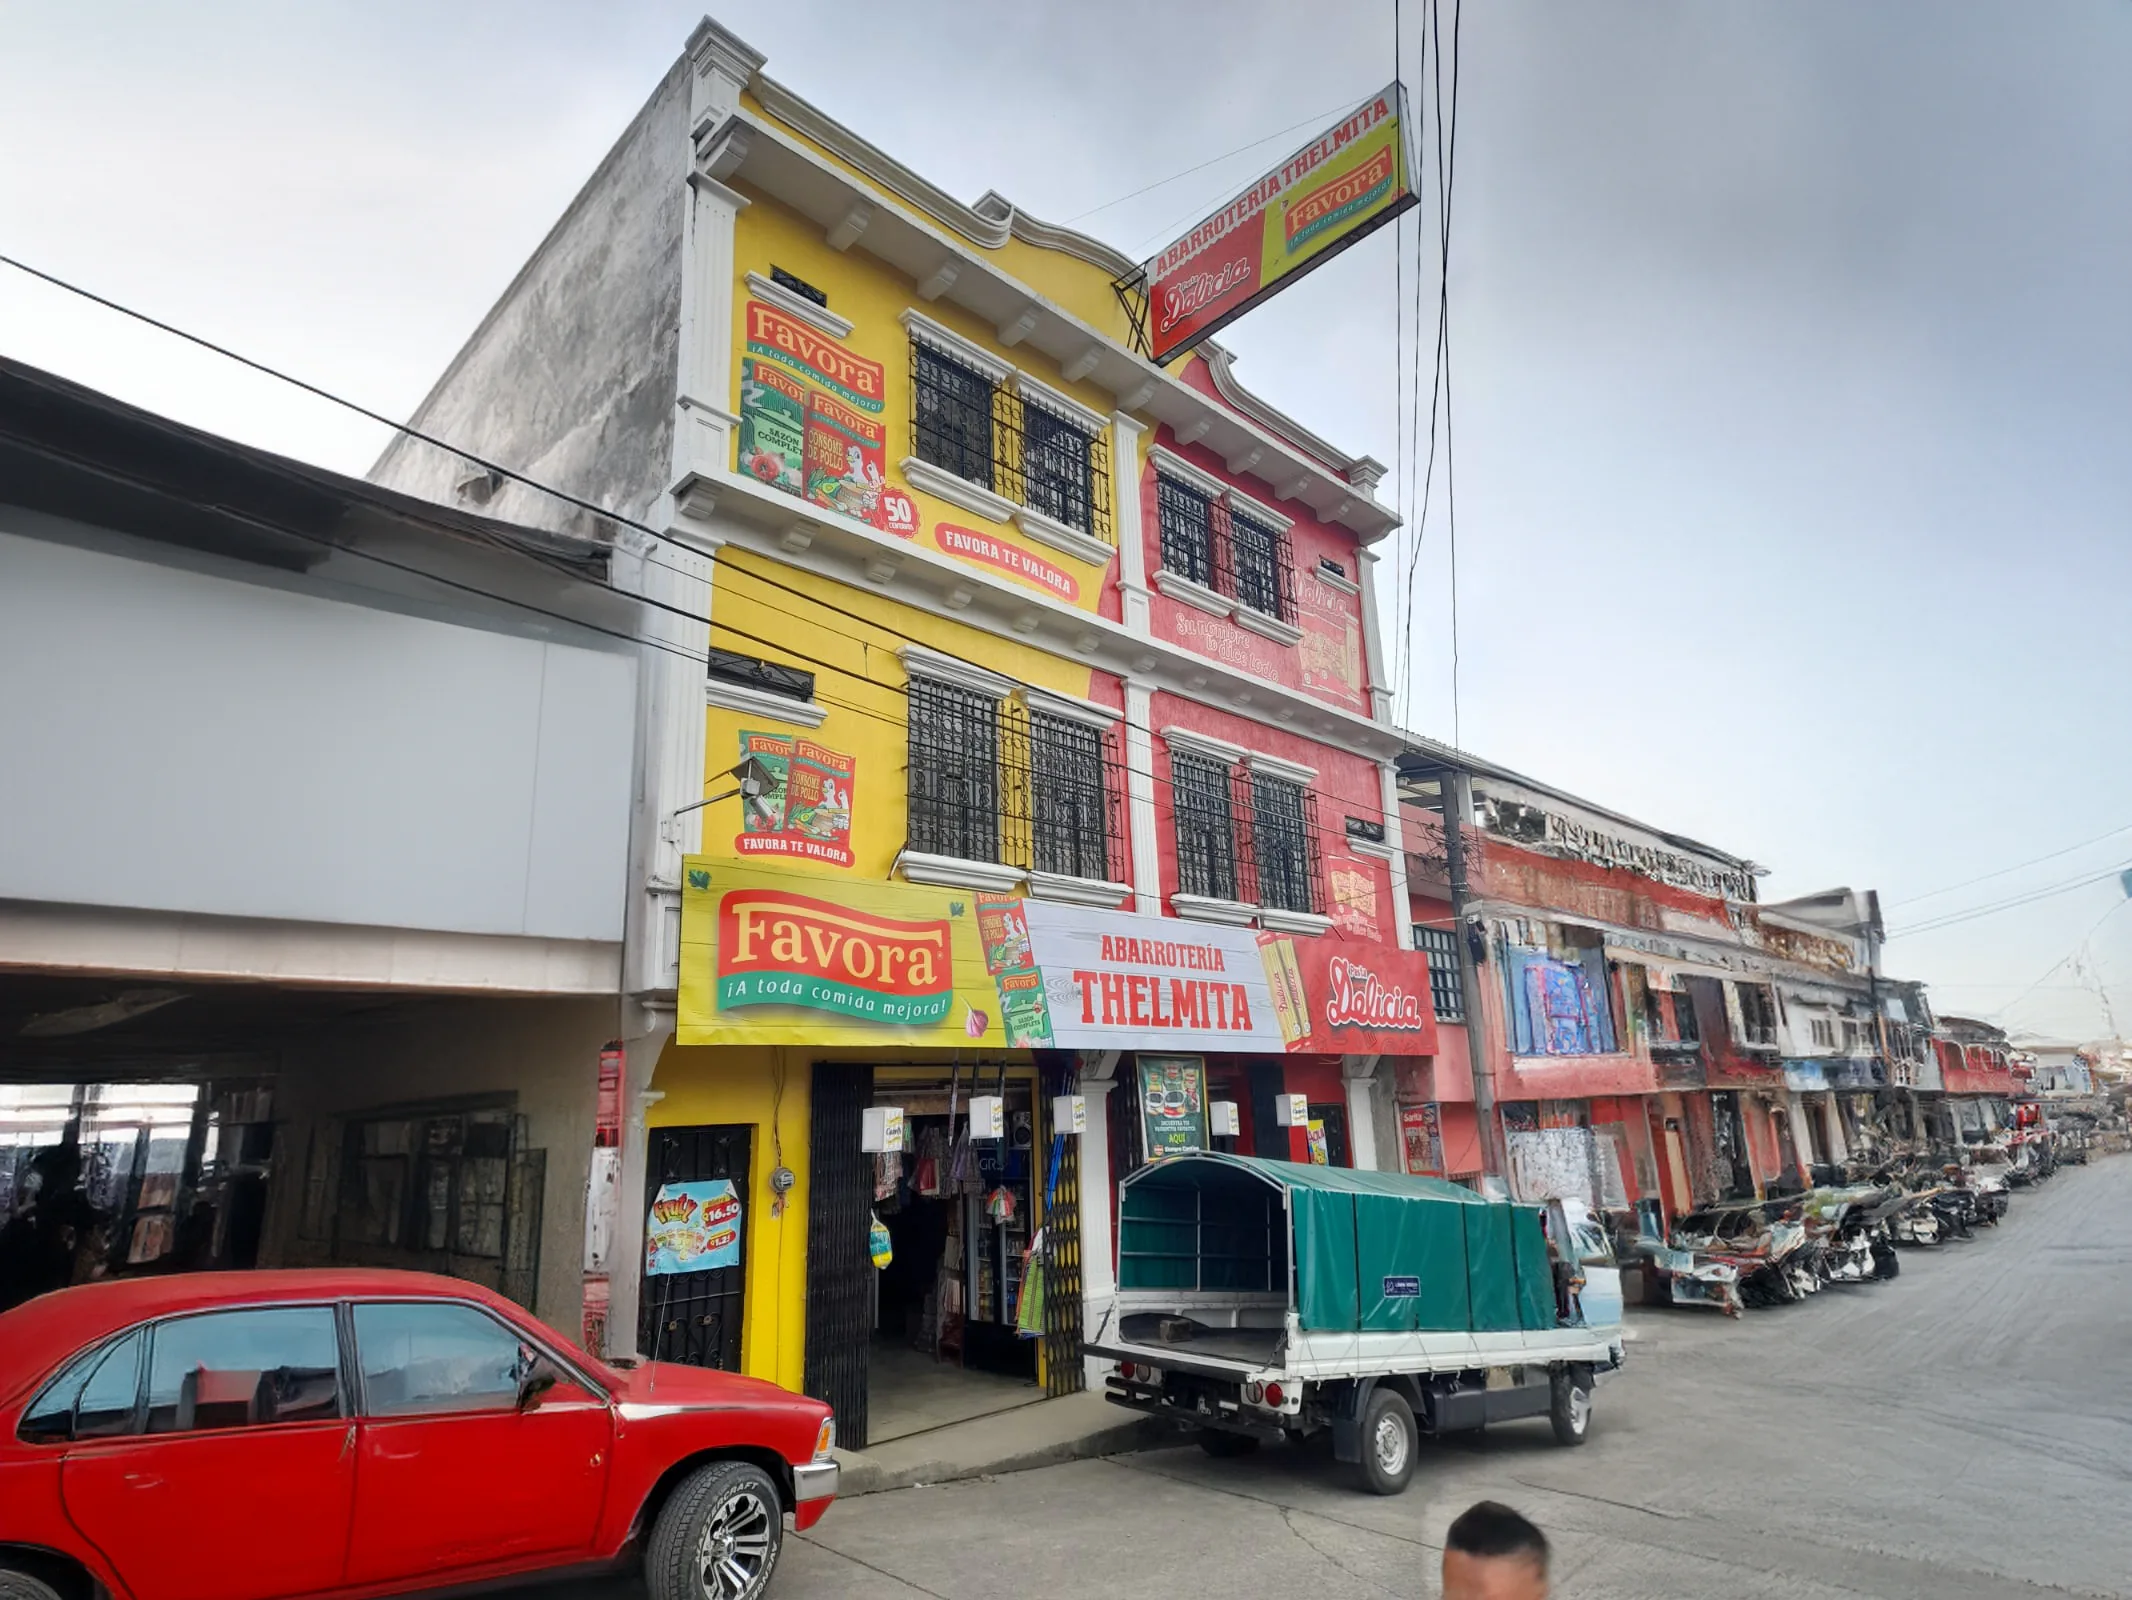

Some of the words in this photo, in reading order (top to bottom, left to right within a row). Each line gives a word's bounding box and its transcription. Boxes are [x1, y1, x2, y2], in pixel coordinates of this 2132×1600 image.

[1156, 176, 1282, 277] ABARROTERÍA
[1282, 97, 1389, 186] THELMITA
[1289, 150, 1388, 236] Favora
[1160, 256, 1251, 333] Delicia
[752, 306, 880, 394] Favora
[769, 349, 794, 367] toda
[799, 364, 838, 392] comida
[842, 390, 882, 412] mejora!
[813, 393, 879, 439] Favora
[820, 449, 843, 471] POLLO
[884, 497, 912, 523] 50
[945, 531, 999, 560] FAVORA
[1002, 549, 1019, 567] TE
[1021, 555, 1072, 594] VALORA
[1176, 612, 1197, 636] Su
[1197, 620, 1251, 649] nombre
[798, 741, 849, 770] Favora
[743, 838, 788, 851] FAVORA
[790, 840, 805, 853] TE
[806, 843, 848, 863] VALORA
[731, 901, 943, 987] Favora
[1101, 934, 1225, 972] ABARROTERÍA
[727, 977, 747, 999] ¡A
[757, 977, 802, 996] toda
[811, 984, 875, 1013] comida
[882, 998, 947, 1023] mejora!
[1004, 974, 1038, 992] Favora
[1073, 970, 1253, 1031] THELMITA
[1326, 956, 1422, 1030] Delicia
[749, 1540, 778, 1600] AVENGE
